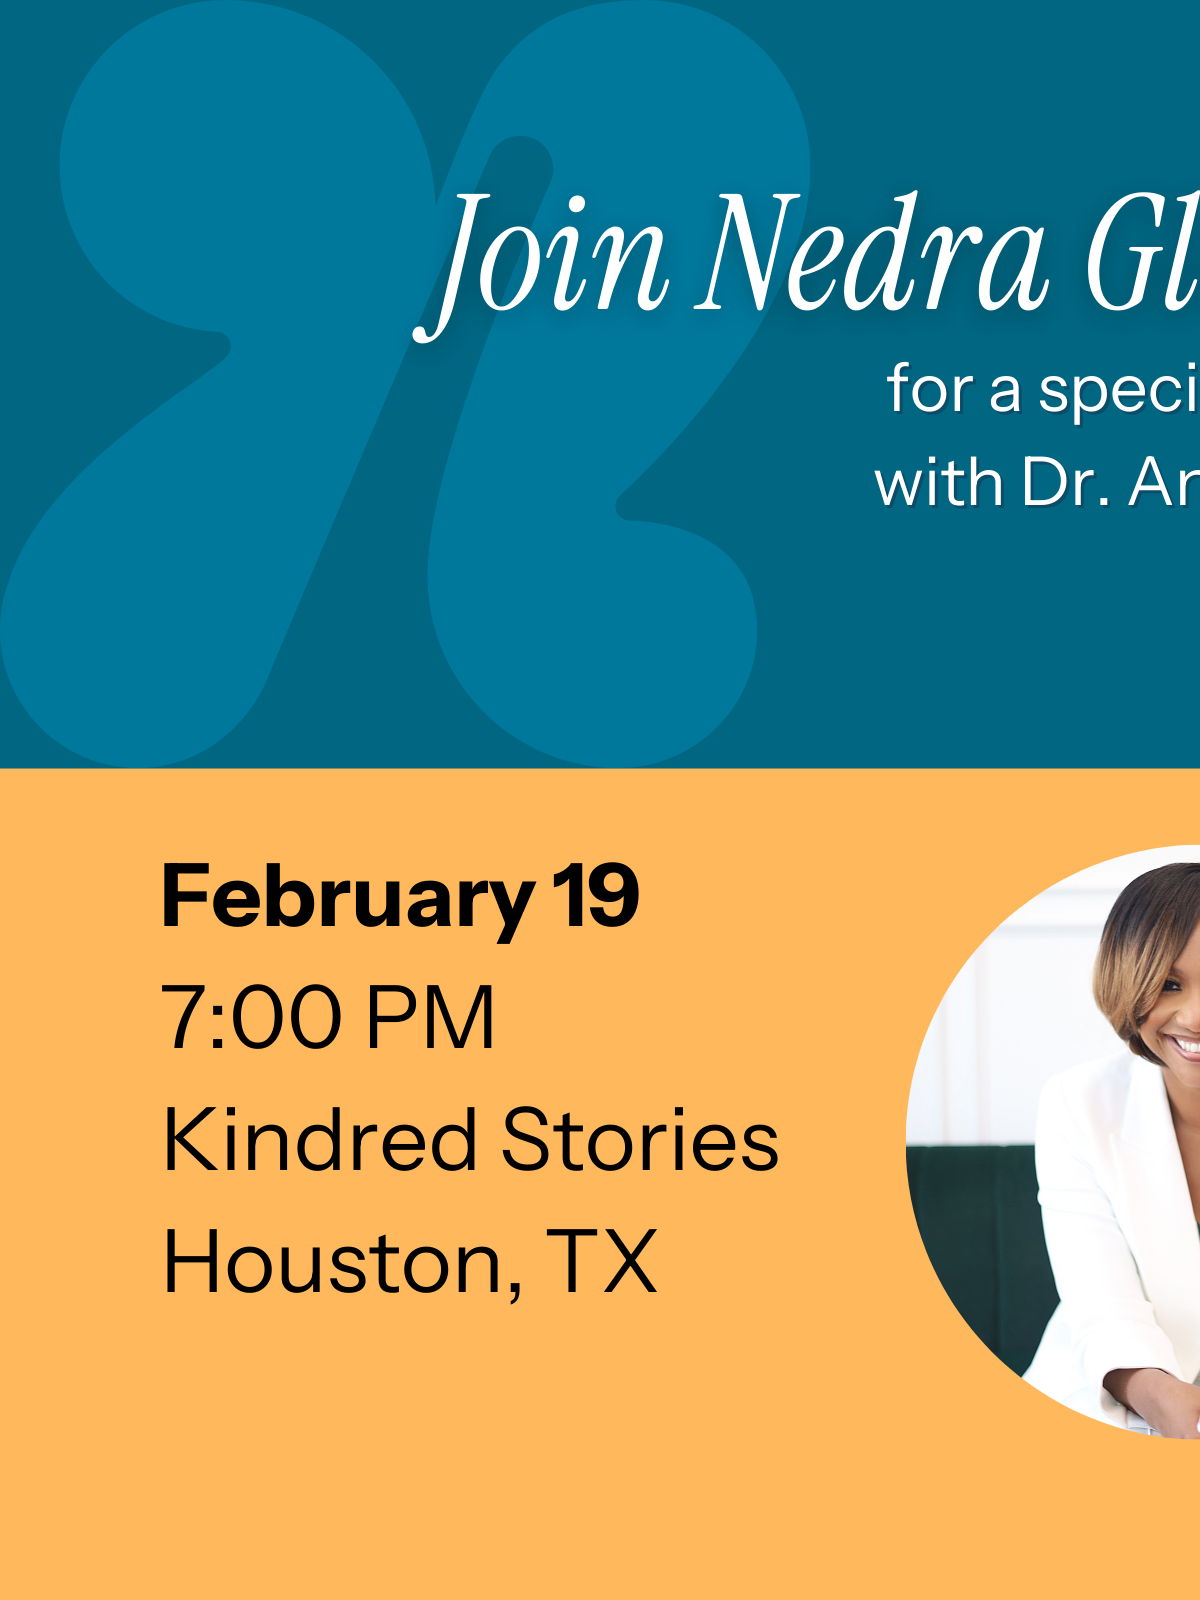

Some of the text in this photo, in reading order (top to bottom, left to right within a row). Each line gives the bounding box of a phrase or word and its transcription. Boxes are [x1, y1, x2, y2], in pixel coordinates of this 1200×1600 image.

[413, 194, 669, 343] Join
[694, 190, 1049, 310] Nedra
[887, 362, 973, 412] for
[991, 376, 1019, 412] a
[875, 457, 1001, 506] with
[1025, 456, 1107, 505] Dr.
[164, 862, 639, 944] February 19
[162, 984, 491, 1049] 7:00 PM
[167, 1106, 778, 1171] Kindred Stories
[167, 1229, 657, 1304] Houston, TX
